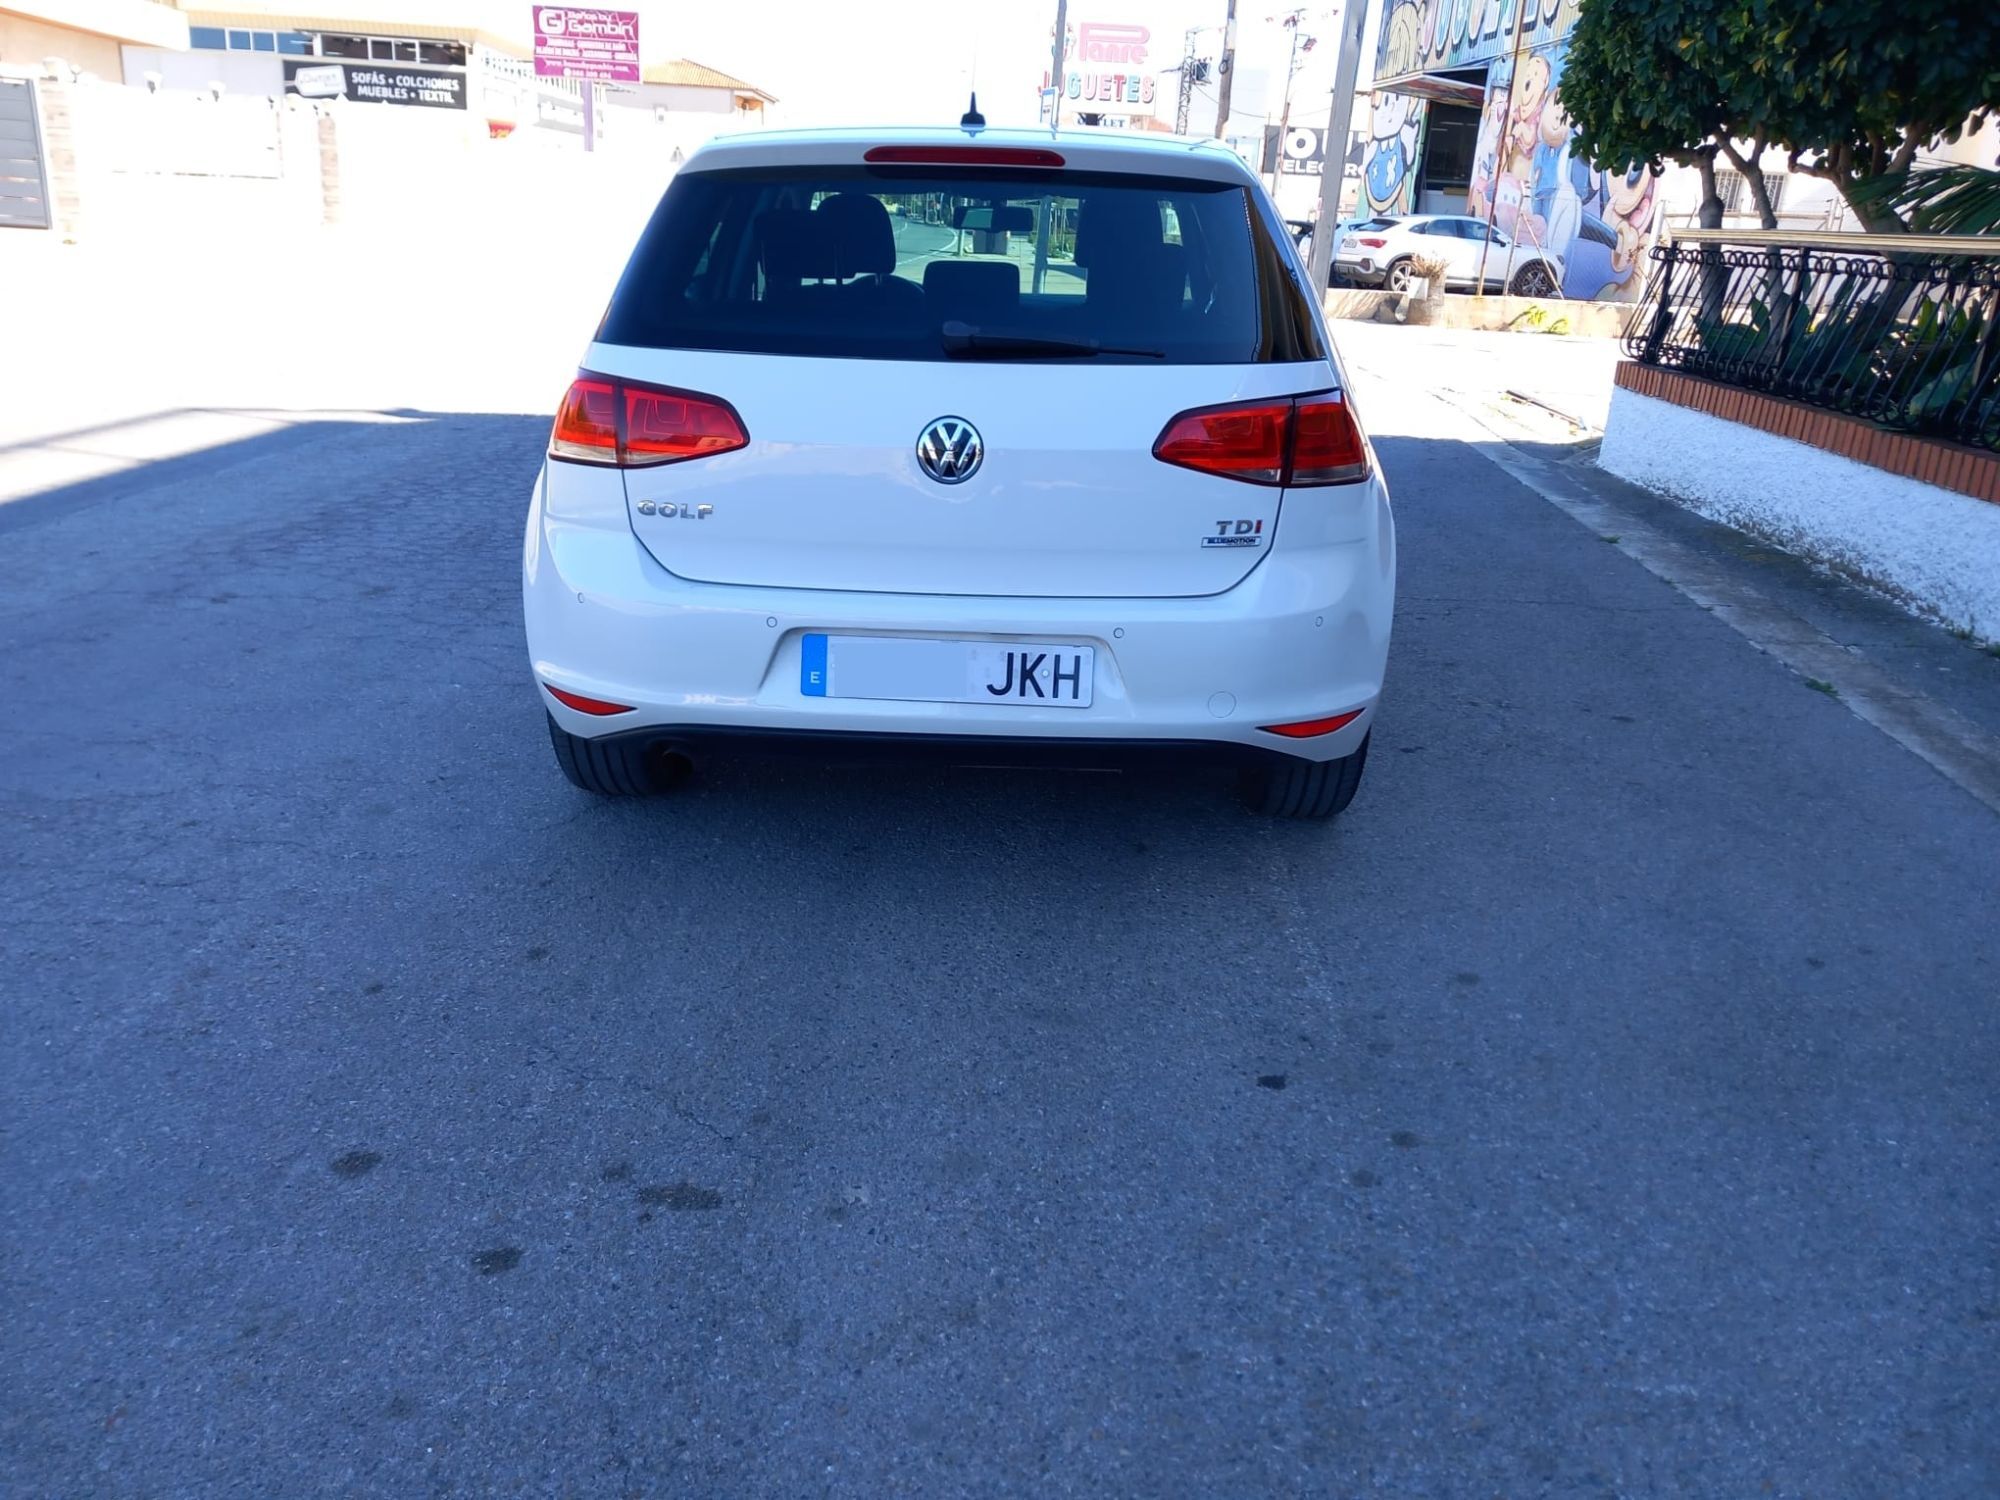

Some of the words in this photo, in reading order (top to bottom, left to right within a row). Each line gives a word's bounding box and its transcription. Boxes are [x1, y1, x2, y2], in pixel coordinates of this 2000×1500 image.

[351, 71, 385, 85] SOFÁS
[396, 75, 460, 91] COLCHONES
[357, 85, 408, 99] MUEBLES
[418, 89, 455, 103] TEXTIL
[637, 500, 714, 520] GOLF
[1216, 519, 1263, 536] TDI
[810, 671, 821, 684] E
[986, 652, 1081, 700] JKH
